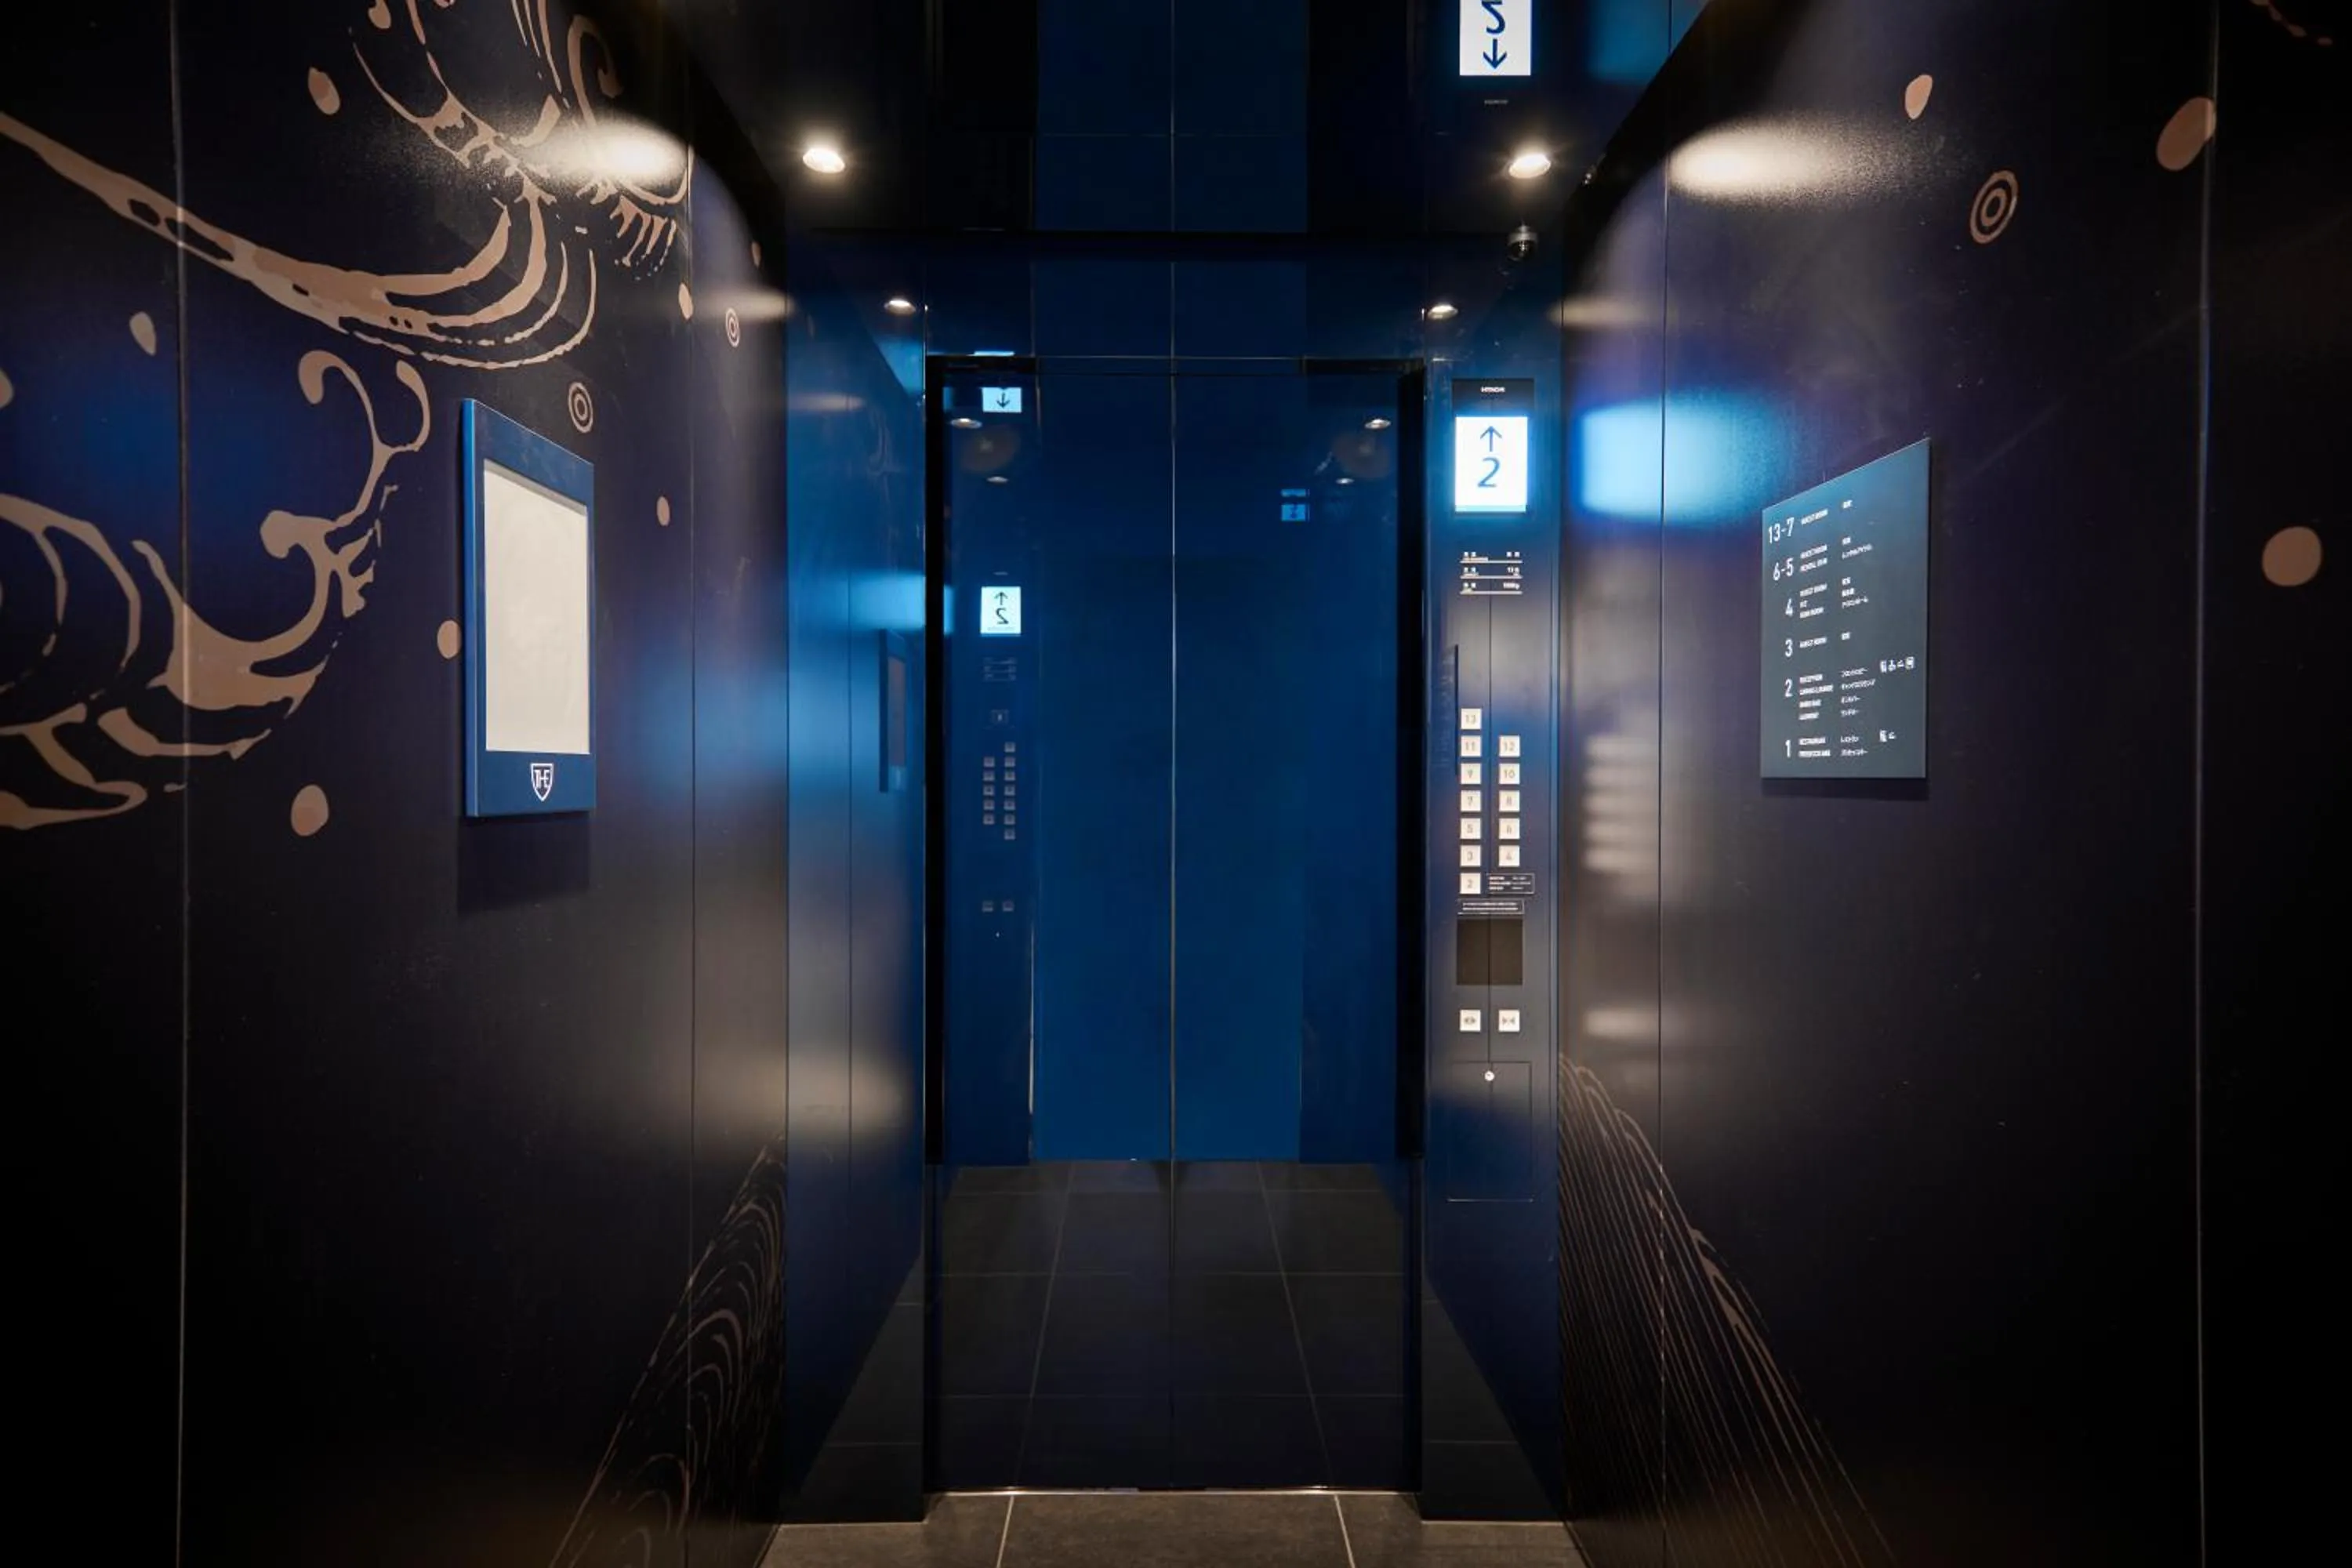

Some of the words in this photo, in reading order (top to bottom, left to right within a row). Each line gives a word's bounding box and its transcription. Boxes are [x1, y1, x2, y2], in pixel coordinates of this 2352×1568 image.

[1477, 456, 1501, 488] 2
[1768, 517, 1795, 544] 13-7
[1773, 557, 1794, 581] 6-5
[1785, 597, 1793, 617] 4
[1784, 638, 1793, 657] 3
[1784, 678, 1793, 698] 2
[1784, 739, 1791, 758] 1
